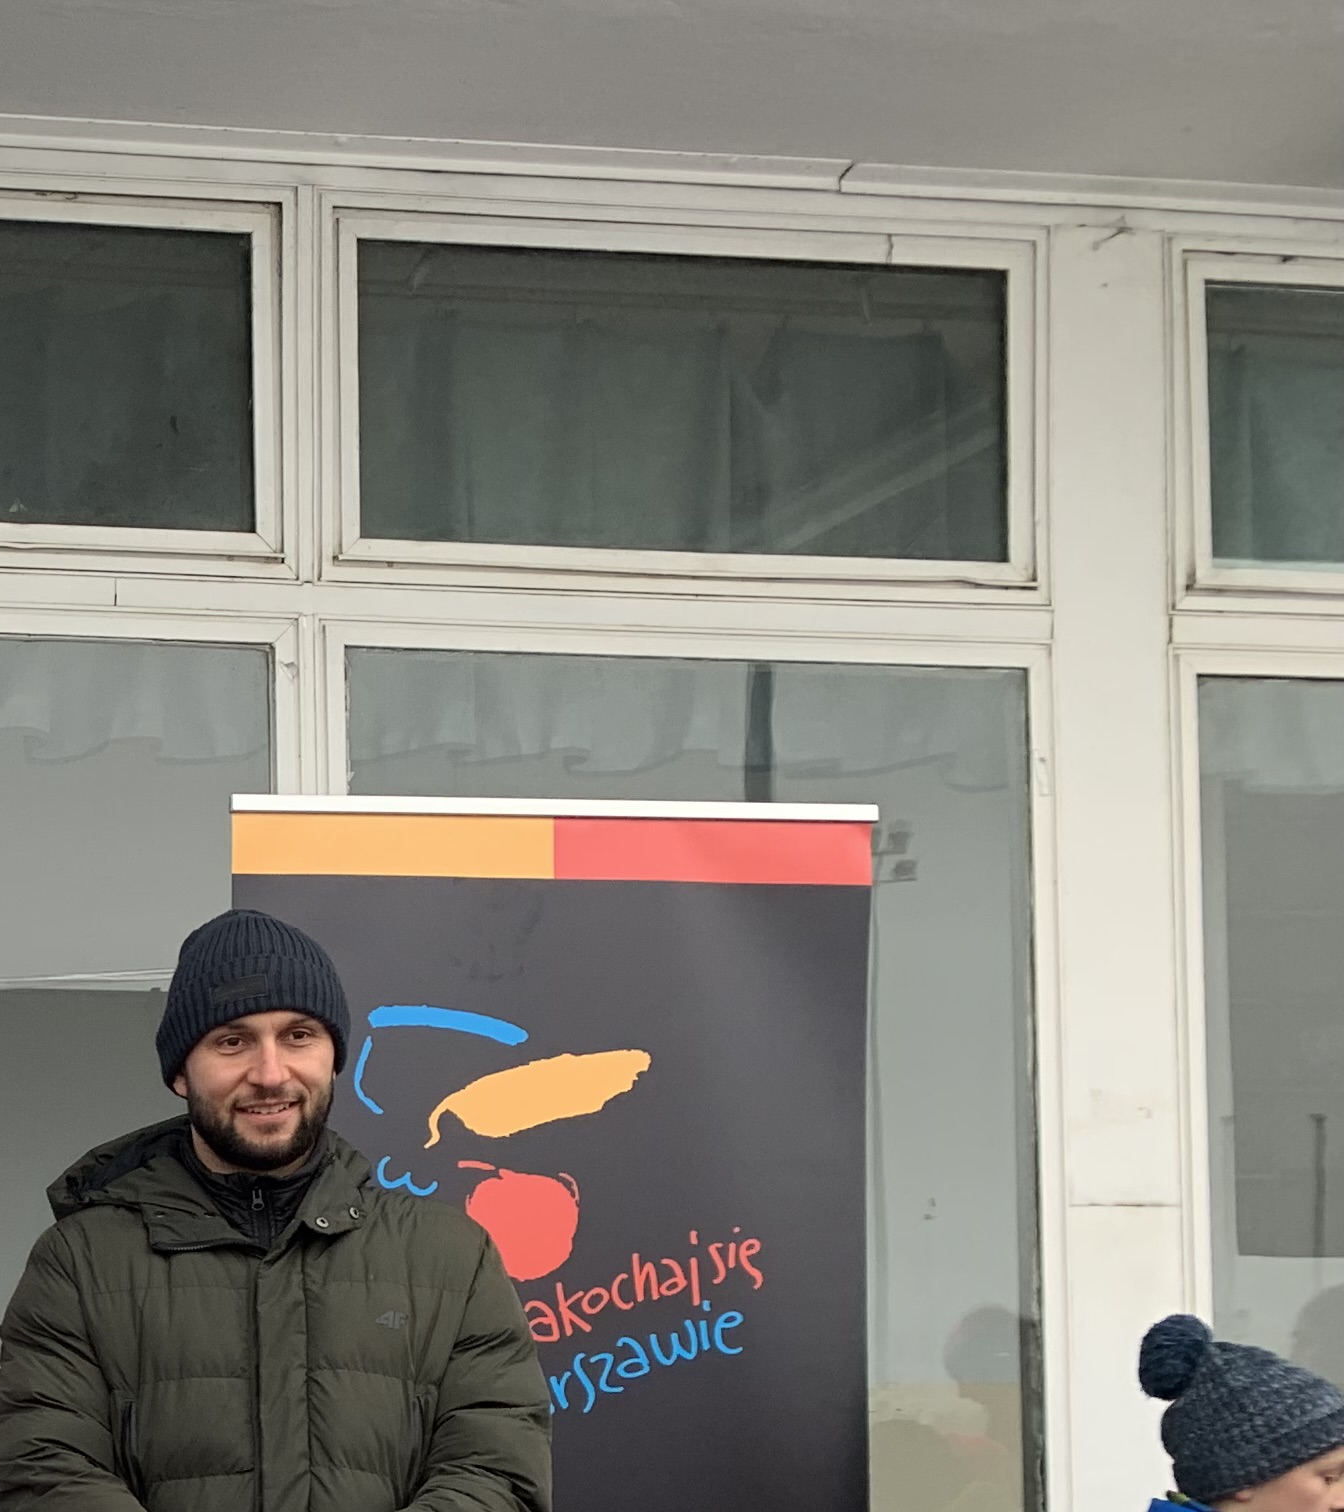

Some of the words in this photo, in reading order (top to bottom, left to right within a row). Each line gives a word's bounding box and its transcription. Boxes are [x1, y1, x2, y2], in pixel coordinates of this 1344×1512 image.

[375, 1310, 408, 1330] 4F
[524, 1230, 700, 1342] akochaj
[708, 1226, 764, 1290] się
[549, 1300, 745, 1414] rszawie
